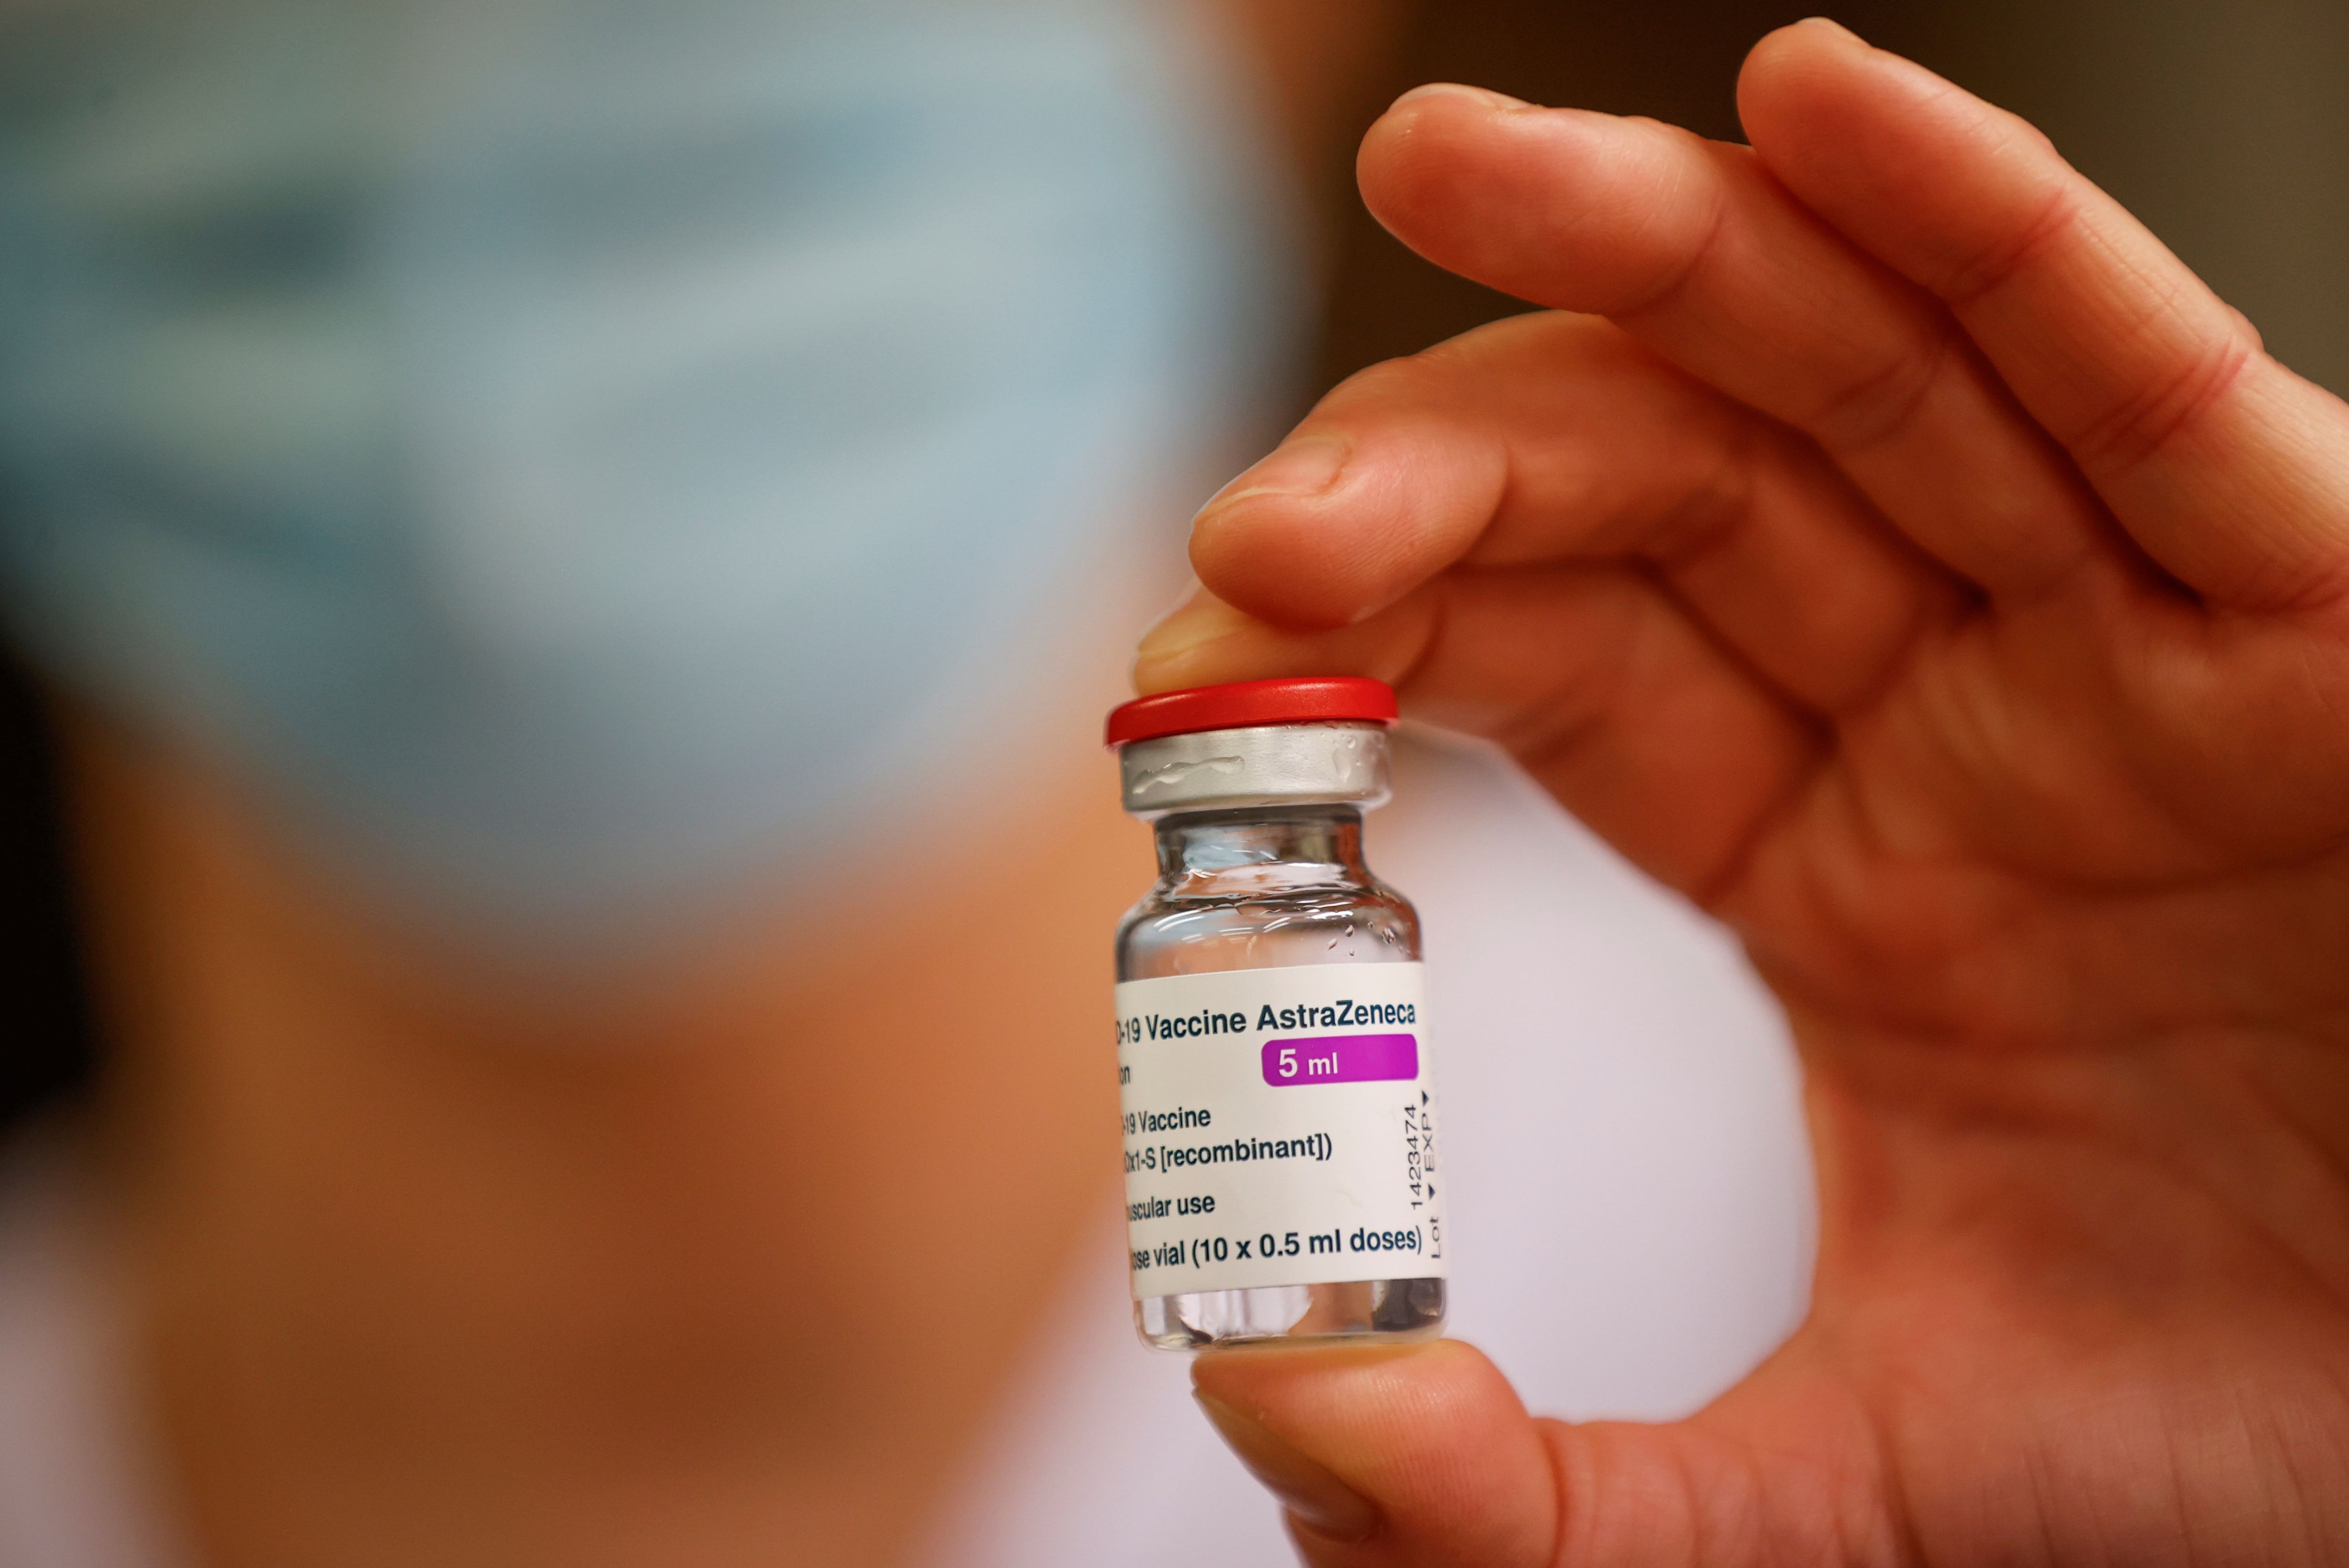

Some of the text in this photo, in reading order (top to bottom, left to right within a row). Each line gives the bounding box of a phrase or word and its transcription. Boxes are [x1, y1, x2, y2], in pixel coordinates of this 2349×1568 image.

[1145, 1009, 1246, 1040] Vaccine
[1256, 1000, 1416, 1031] AstraZeneca
[1279, 1048, 1338, 1077] 5 ml
[1121, 1107, 1211, 1135] -19 Vaccine
[1161, 1133, 1332, 1173] [recombinant])
[1405, 1104, 1423, 1211] 1423474
[1421, 1112, 1441, 1259] Lot EXP
[1177, 1196, 1215, 1216] use
[1153, 1240, 1185, 1267] vial
[1192, 1237, 1228, 1269] (10
[1236, 1240, 1252, 1259] x
[1260, 1232, 1300, 1258] 0.5
[1309, 1229, 1341, 1254] ml
[1350, 1225, 1422, 1255] doses)
